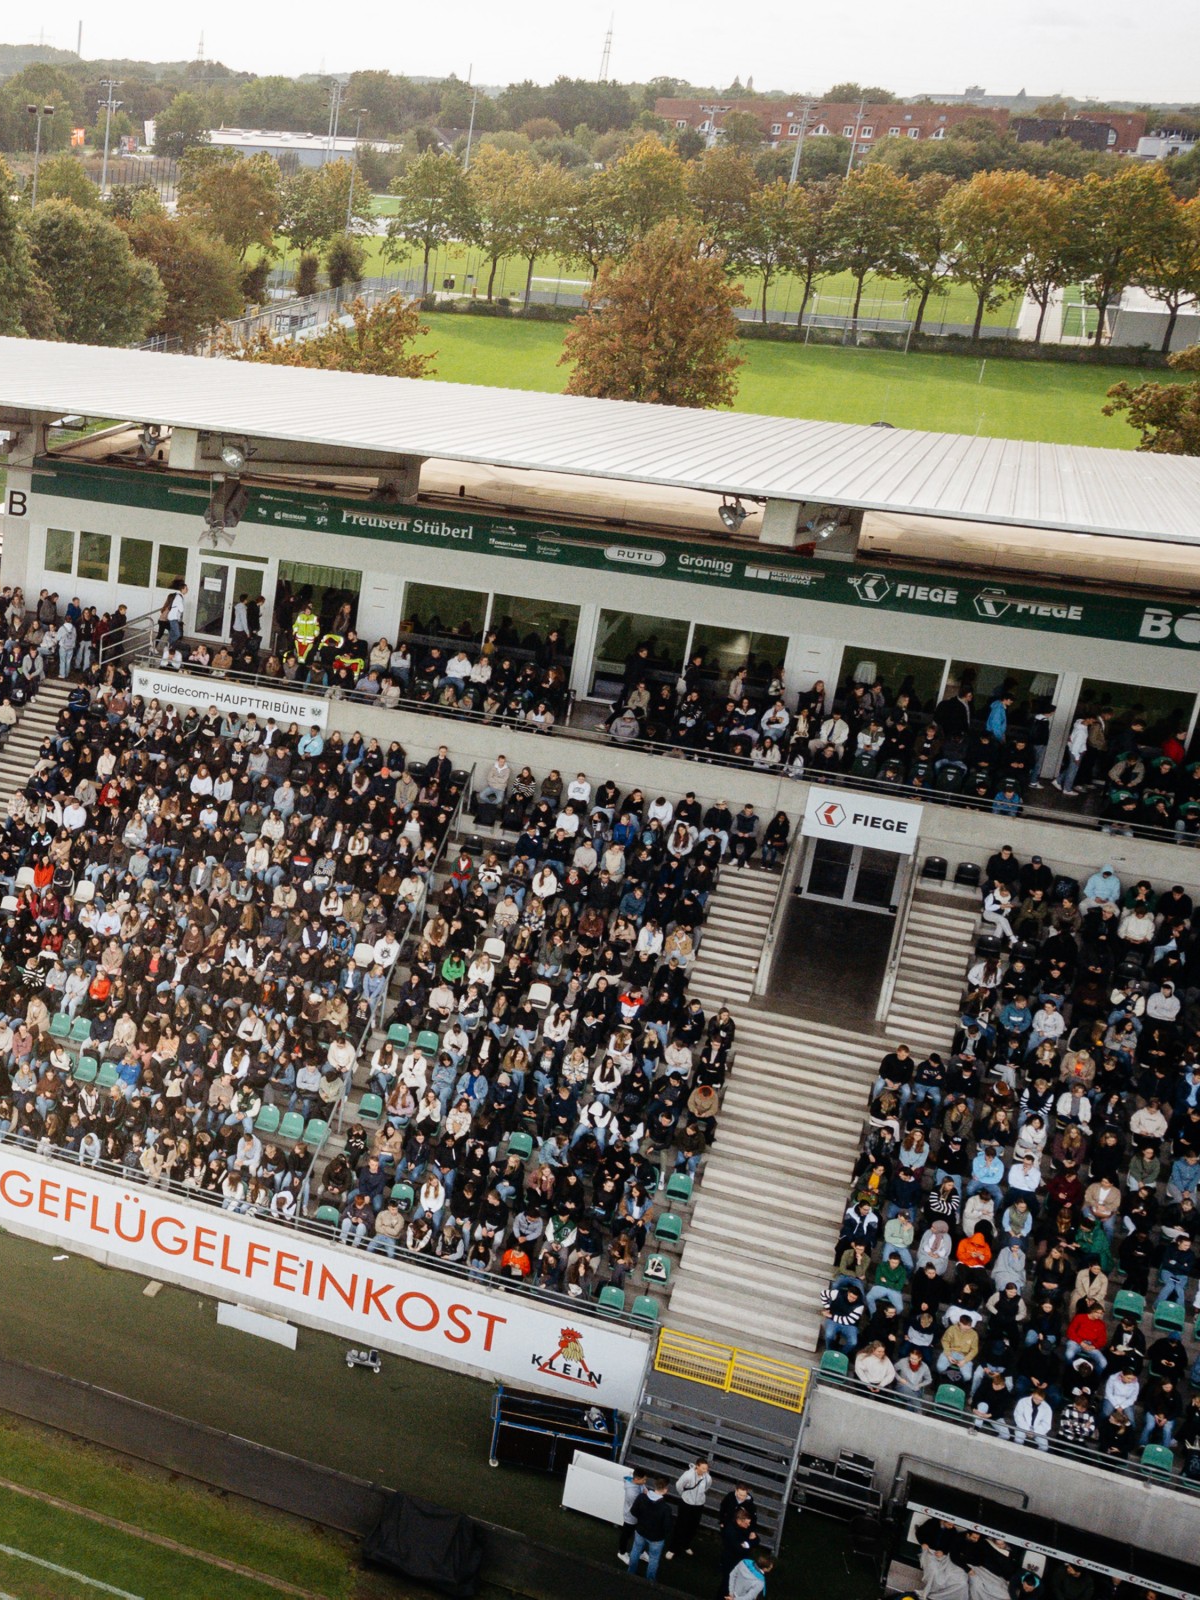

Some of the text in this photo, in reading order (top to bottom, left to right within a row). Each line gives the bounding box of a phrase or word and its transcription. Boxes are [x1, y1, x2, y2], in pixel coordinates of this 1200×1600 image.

[8, 490, 28, 516] B
[412, 519, 473, 540] Stüberl
[617, 549, 653, 562] RUTU
[678, 554, 734, 574] Gröning
[895, 584, 959, 604] FIEGE
[1016, 602, 1084, 621] FIEGE
[153, 683, 306, 717] guidecom-HAUPTTRIBÜNE
[852, 813, 909, 834] FIEGE
[0, 1169, 507, 1352] GEFLÜGELFEINKOST
[531, 1353, 602, 1384] KLEIN
